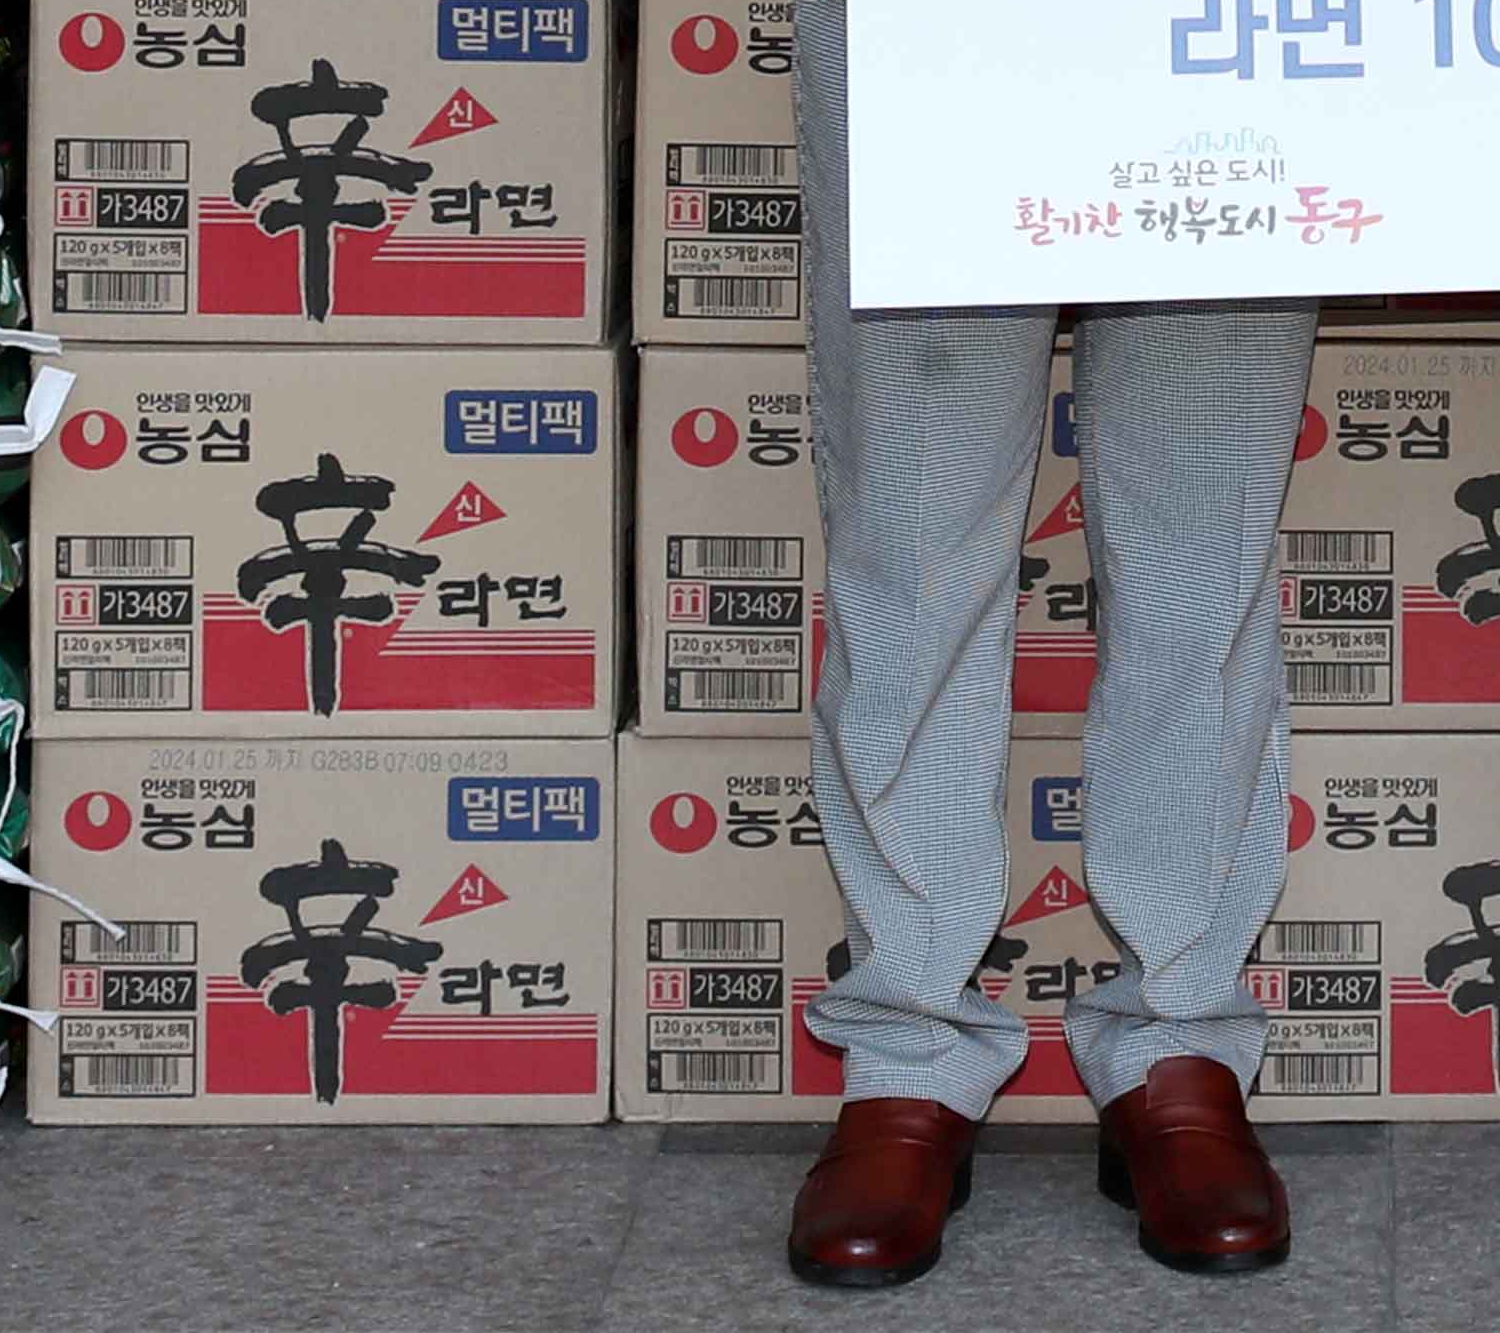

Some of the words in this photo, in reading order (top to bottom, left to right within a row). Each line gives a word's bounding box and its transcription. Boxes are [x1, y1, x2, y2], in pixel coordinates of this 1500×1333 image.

[133, 22, 246, 69] 농심
[451, 7, 574, 53] 멀티팩
[232, 58, 433, 322] 辛
[1109, 161, 1161, 188] 살고
[1168, 159, 1219, 188] 싶은
[1228, 159, 1286, 184] 도시!
[101, 194, 184, 223] 가3487
[429, 180, 557, 235] 라면
[712, 197, 798, 229] 가3487
[1014, 197, 1122, 245] 활기찬
[1134, 197, 1276, 245] 행복도시
[1285, 186, 1383, 245] 동구
[136, 417, 251, 465] 농심
[459, 400, 584, 445] 멀티팩
[1336, 414, 1450, 460] 농심
[102, 591, 187, 620] 가3487
[437, 572, 567, 627] 라면
[1304, 584, 1389, 614] 가3487
[140, 803, 255, 851] 농심
[461, 786, 586, 831] 멀티팩
[1324, 802, 1437, 849] 농심
[107, 976, 191, 1006] 가3487
[440, 959, 570, 1014] 라면
[693, 974, 777, 1003] 가3487
